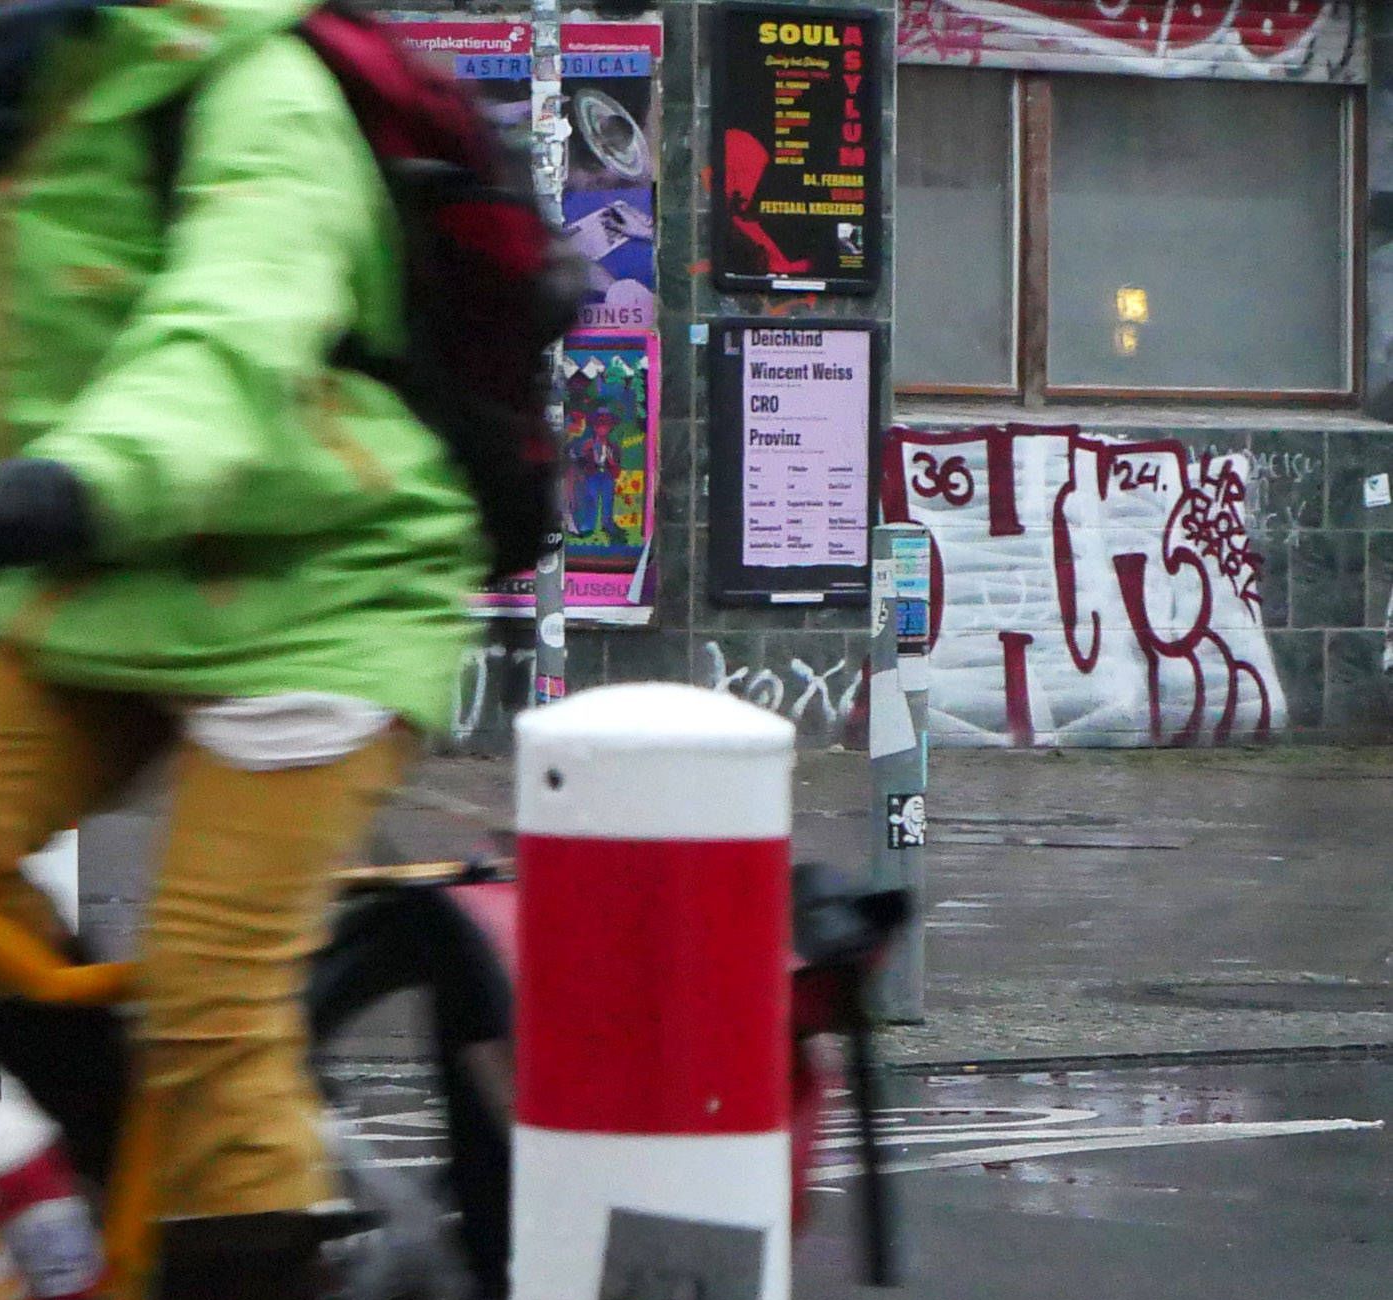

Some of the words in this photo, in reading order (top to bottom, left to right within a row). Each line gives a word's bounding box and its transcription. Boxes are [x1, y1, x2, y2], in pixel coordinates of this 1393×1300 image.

[759, 22, 840, 46] SOUL
[838, 26, 866, 167] ASYLUM
[579, 307, 643, 324] DINGS
[751, 328, 824, 347] Deichkind
[749, 361, 808, 380] Wincent
[812, 362, 854, 380] Weiss
[751, 395, 780, 413] CRO
[749, 428, 802, 446] Provinz
